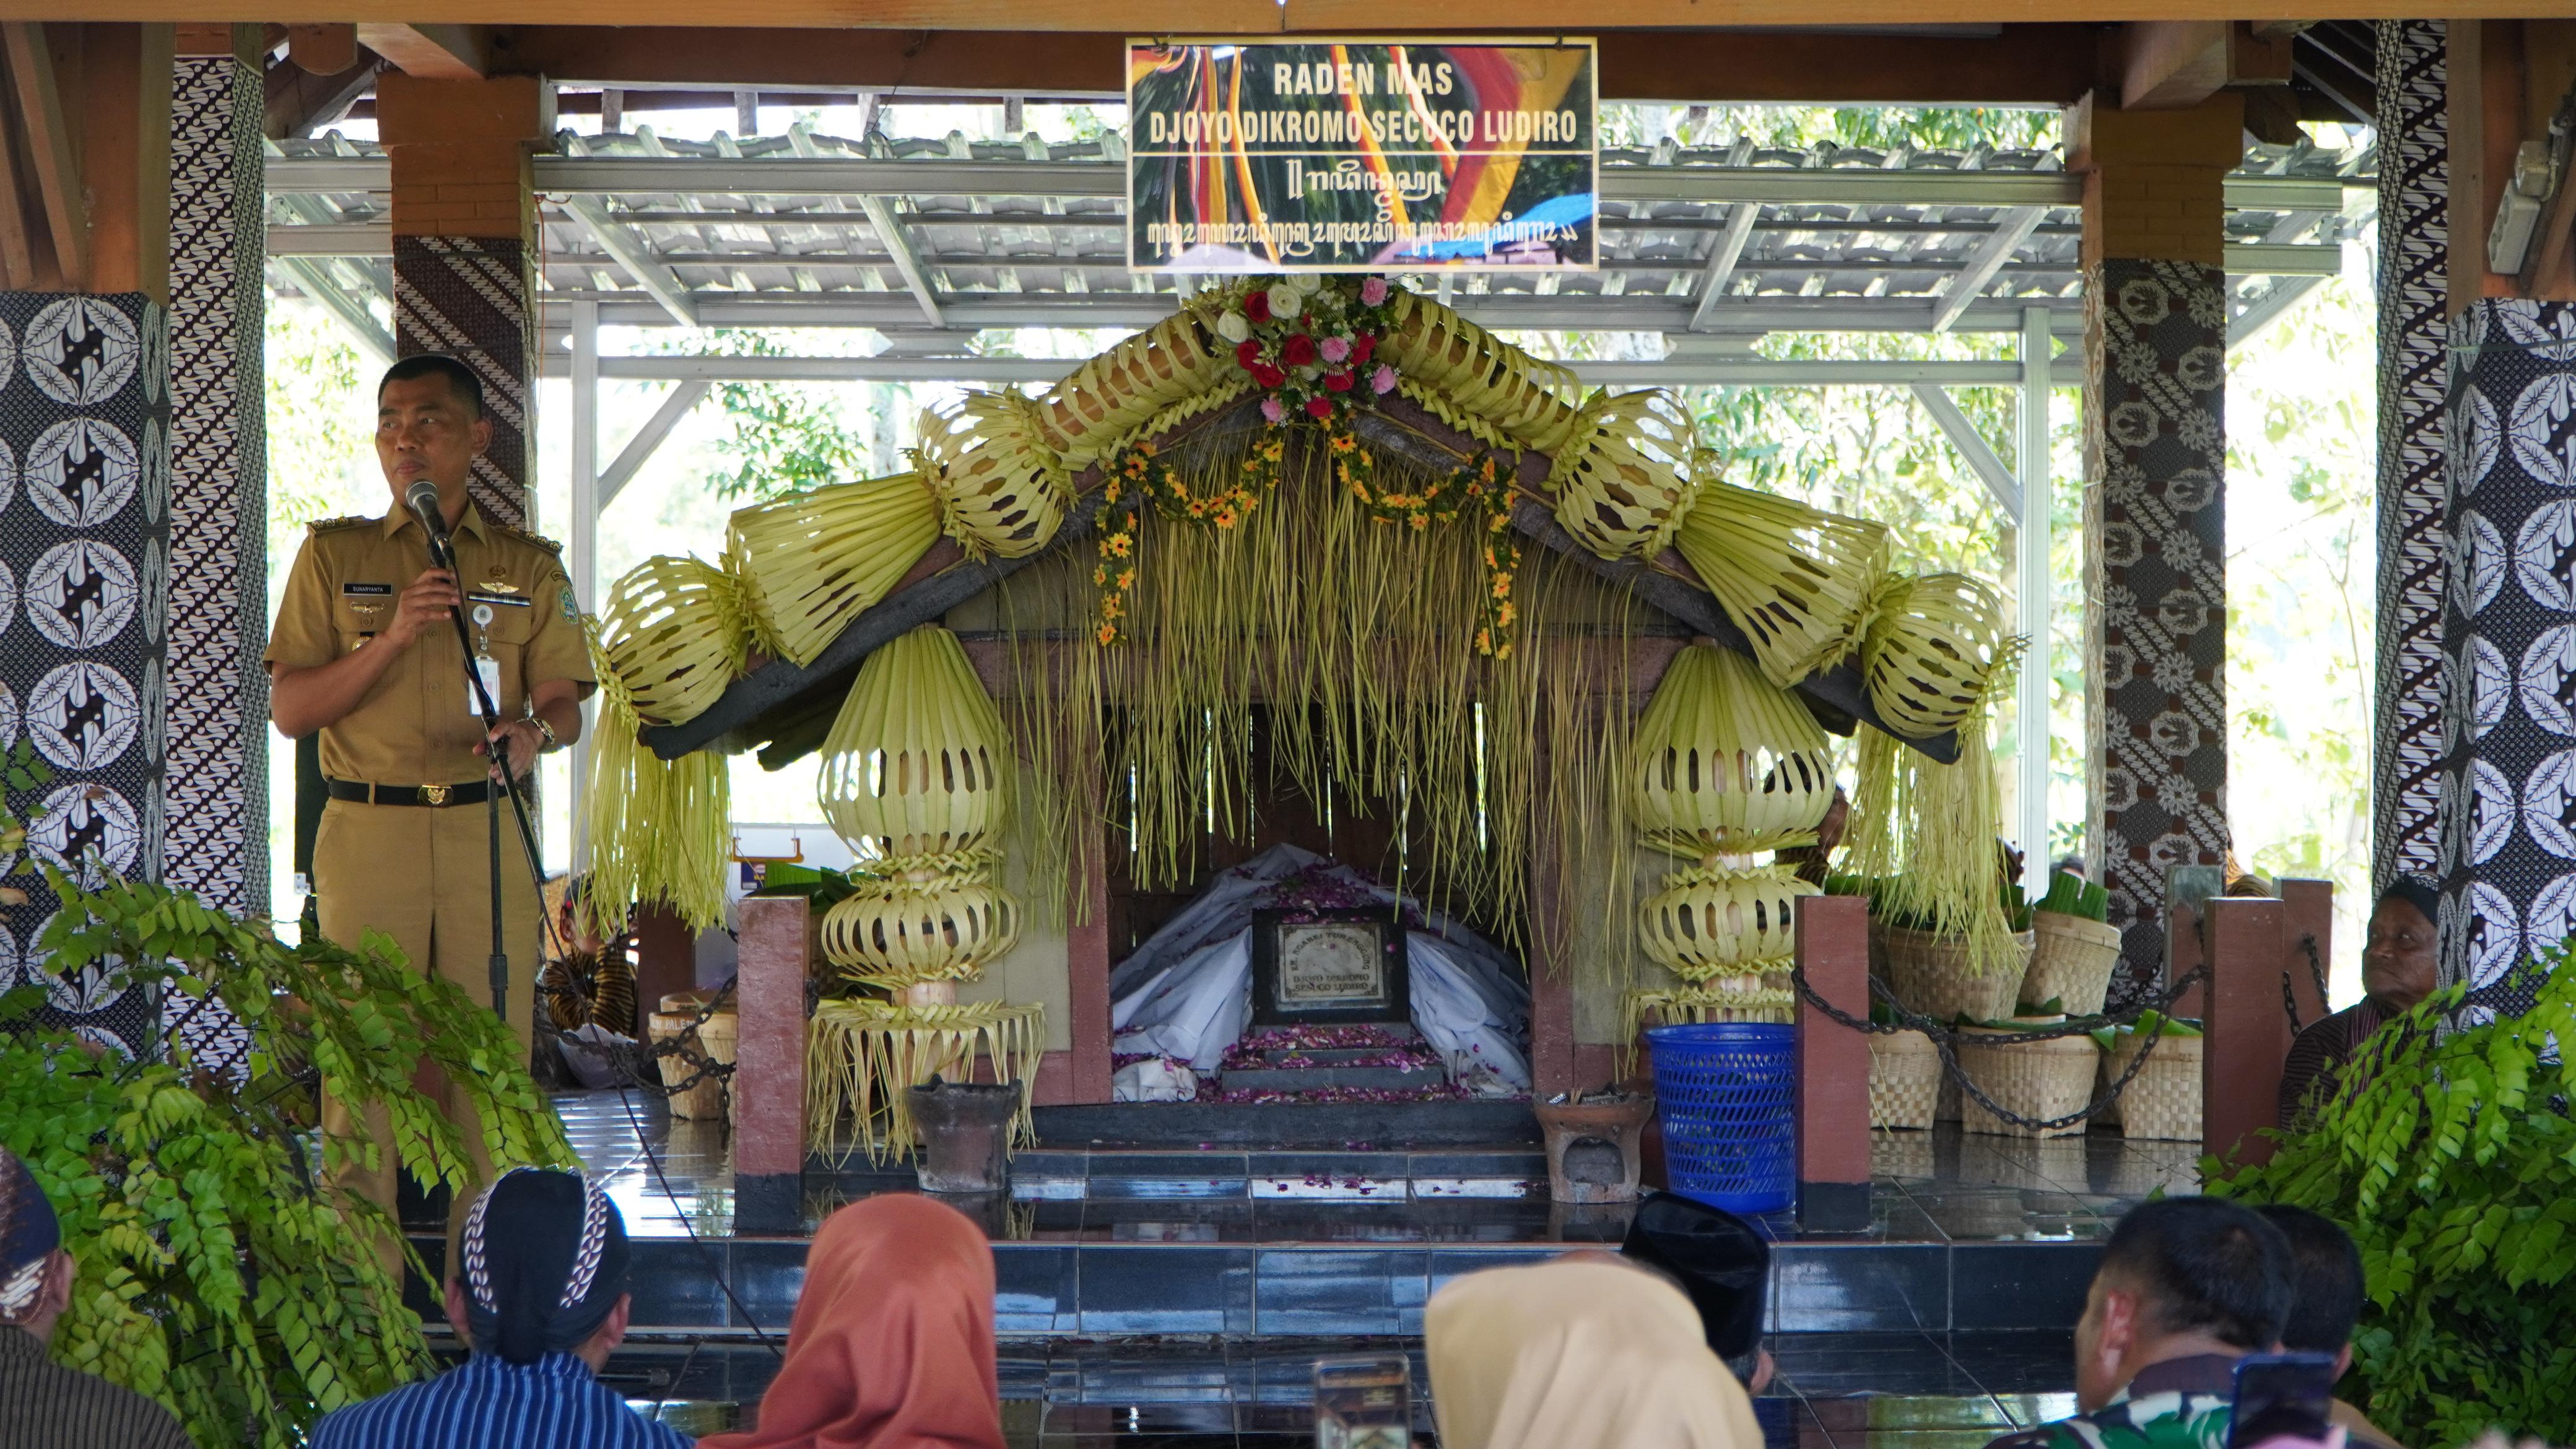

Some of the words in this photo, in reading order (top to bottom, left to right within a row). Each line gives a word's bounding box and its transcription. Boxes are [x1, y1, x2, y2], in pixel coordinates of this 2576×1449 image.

[1274, 63, 1375, 95] RADEN
[1386, 63, 1453, 95] MAS
[1150, 111, 1234, 144] DJOYO
[1243, 110, 1362, 144] DIKROMO
[1372, 110, 1474, 143] SECUCO
[1484, 110, 1577, 143] LUDIRO
